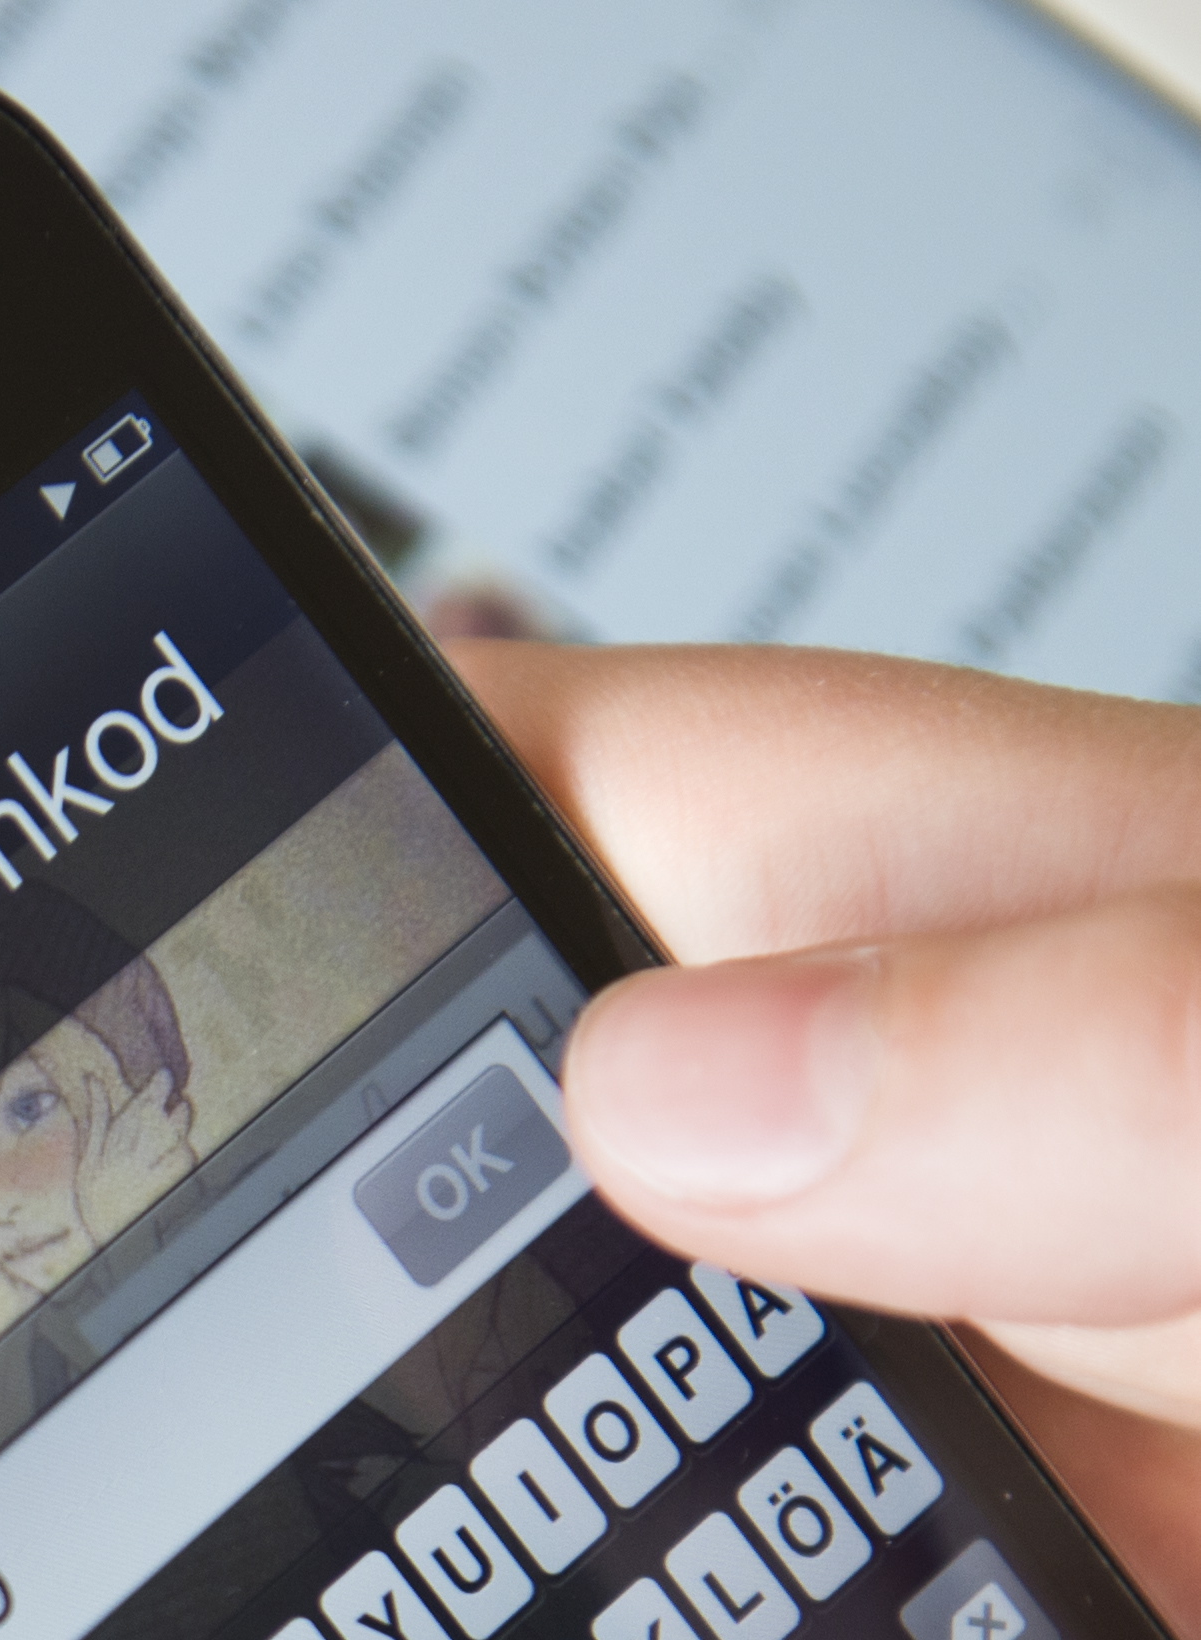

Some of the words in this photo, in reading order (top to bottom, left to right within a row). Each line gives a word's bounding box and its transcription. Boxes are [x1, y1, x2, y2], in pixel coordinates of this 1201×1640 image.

[415, 1122, 516, 1221] OK
[430, 1525, 494, 1596] U
[582, 1399, 641, 1465] O
[652, 1334, 702, 1403] P
[701, 1571, 765, 1625] L
[767, 1481, 834, 1559] Ö
[839, 1415, 913, 1499] Ä
